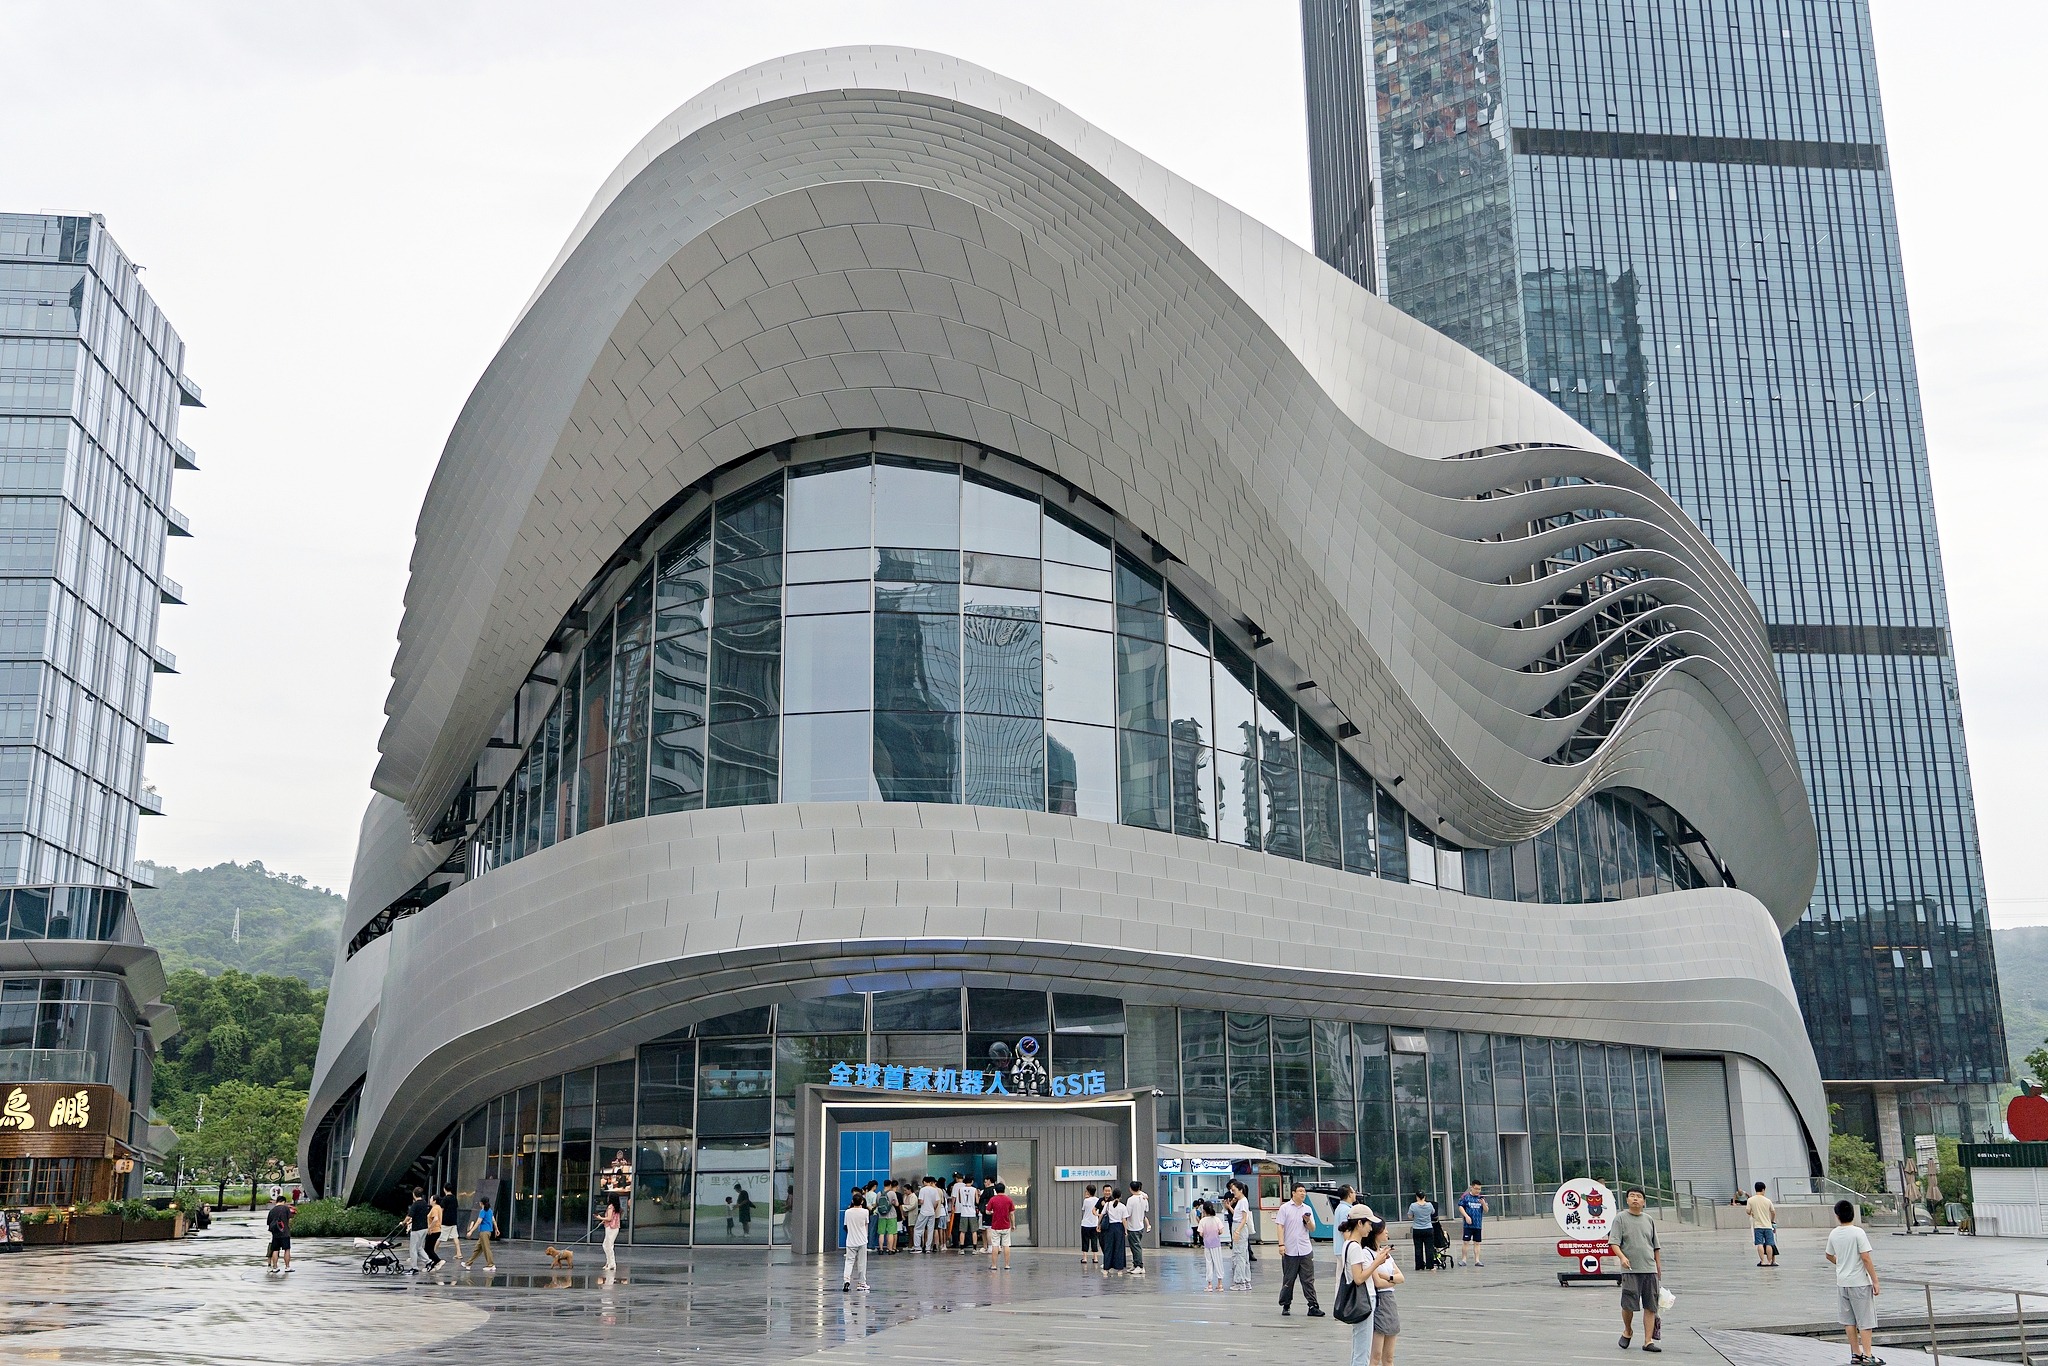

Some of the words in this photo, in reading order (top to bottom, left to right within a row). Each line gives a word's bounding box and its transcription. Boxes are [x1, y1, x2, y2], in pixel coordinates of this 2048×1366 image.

[829, 1061, 1009, 1096] 全球首家机器人
[1052, 1070, 1106, 1097] 6S店
[1071, 1169, 1113, 1177] 未来时代机器人
